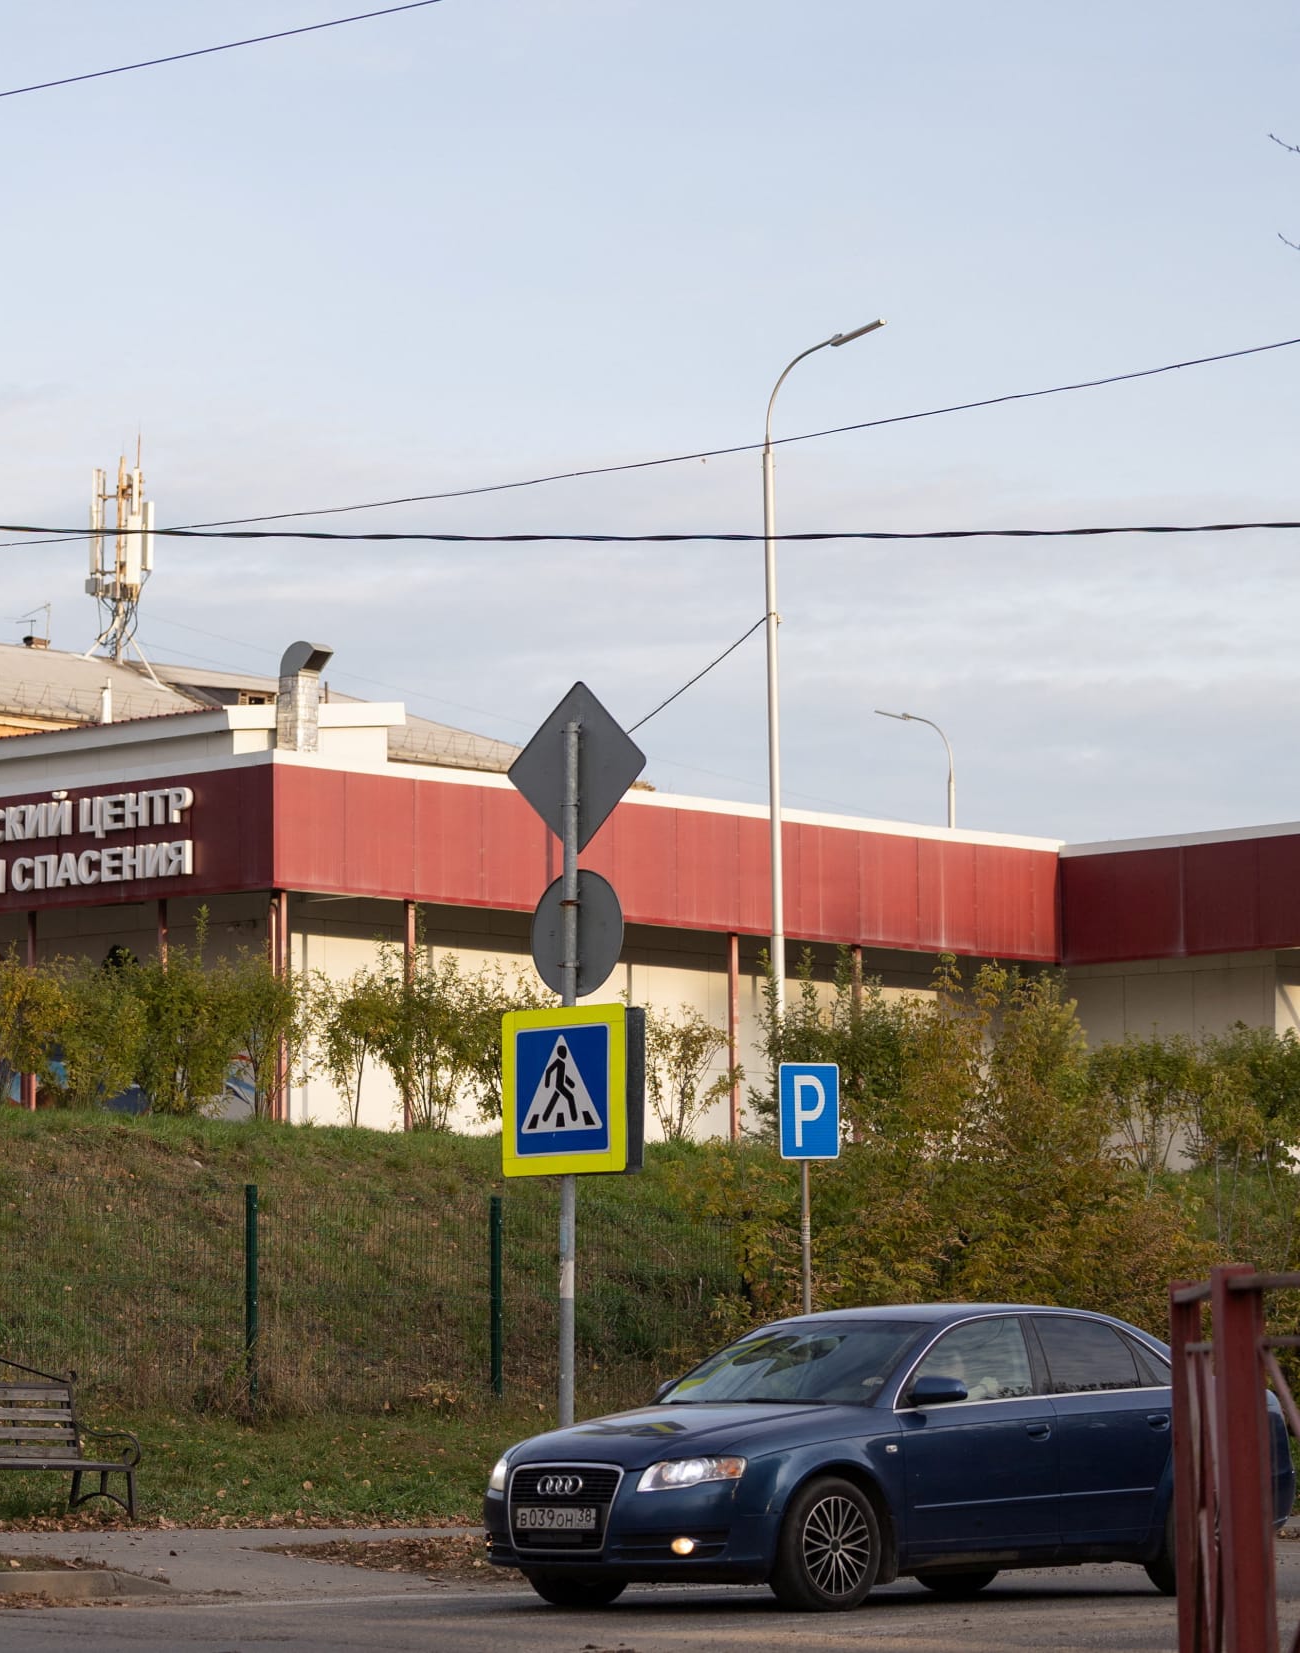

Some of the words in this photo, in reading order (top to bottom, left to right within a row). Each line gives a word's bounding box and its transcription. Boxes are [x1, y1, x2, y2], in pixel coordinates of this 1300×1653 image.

[79, 786, 194, 839] ЦЕНТР
[11, 839, 194, 892] СПАСЕНИЯ
[794, 1075, 825, 1147] P
